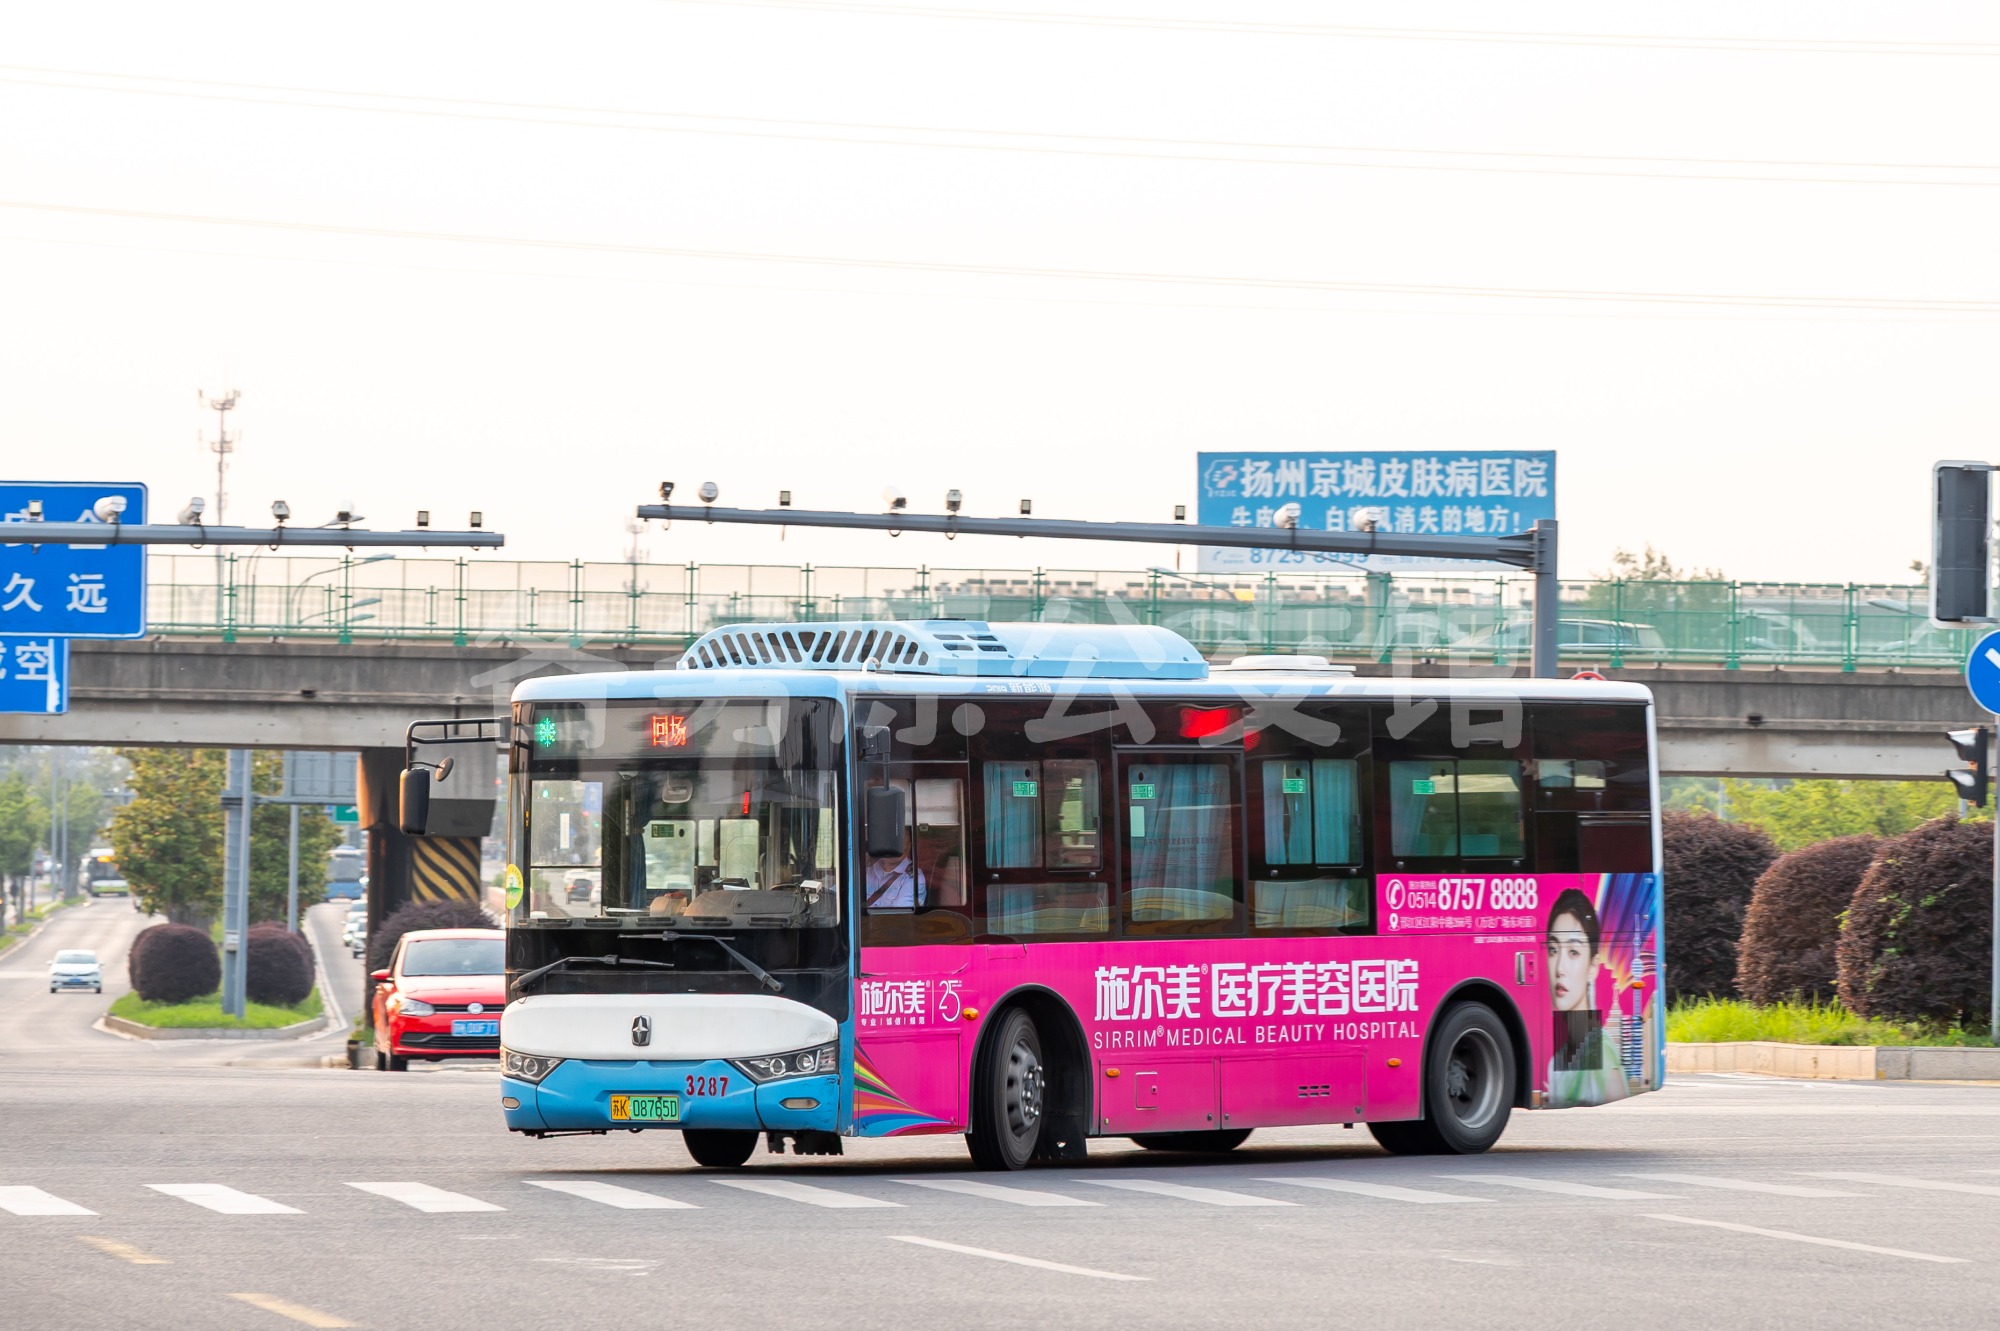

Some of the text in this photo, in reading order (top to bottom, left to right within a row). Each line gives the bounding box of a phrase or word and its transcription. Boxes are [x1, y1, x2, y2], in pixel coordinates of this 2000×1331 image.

[1240, 458, 1547, 498] 扬州京城皮肤病医院
[1250, 547, 1304, 564] 8725
[0, 641, 50, 681] 空
[652, 715, 687, 746] 回场
[1408, 878, 1538, 910] 0514 8757 8888
[861, 980, 925, 1015] 施尔美
[1167, 1026, 1247, 1047] MEDICAL
[1255, 1023, 1325, 1044] BEAUTY
[1333, 1020, 1420, 1041] HOSPITAL
[685, 1074, 729, 1097] 3287
